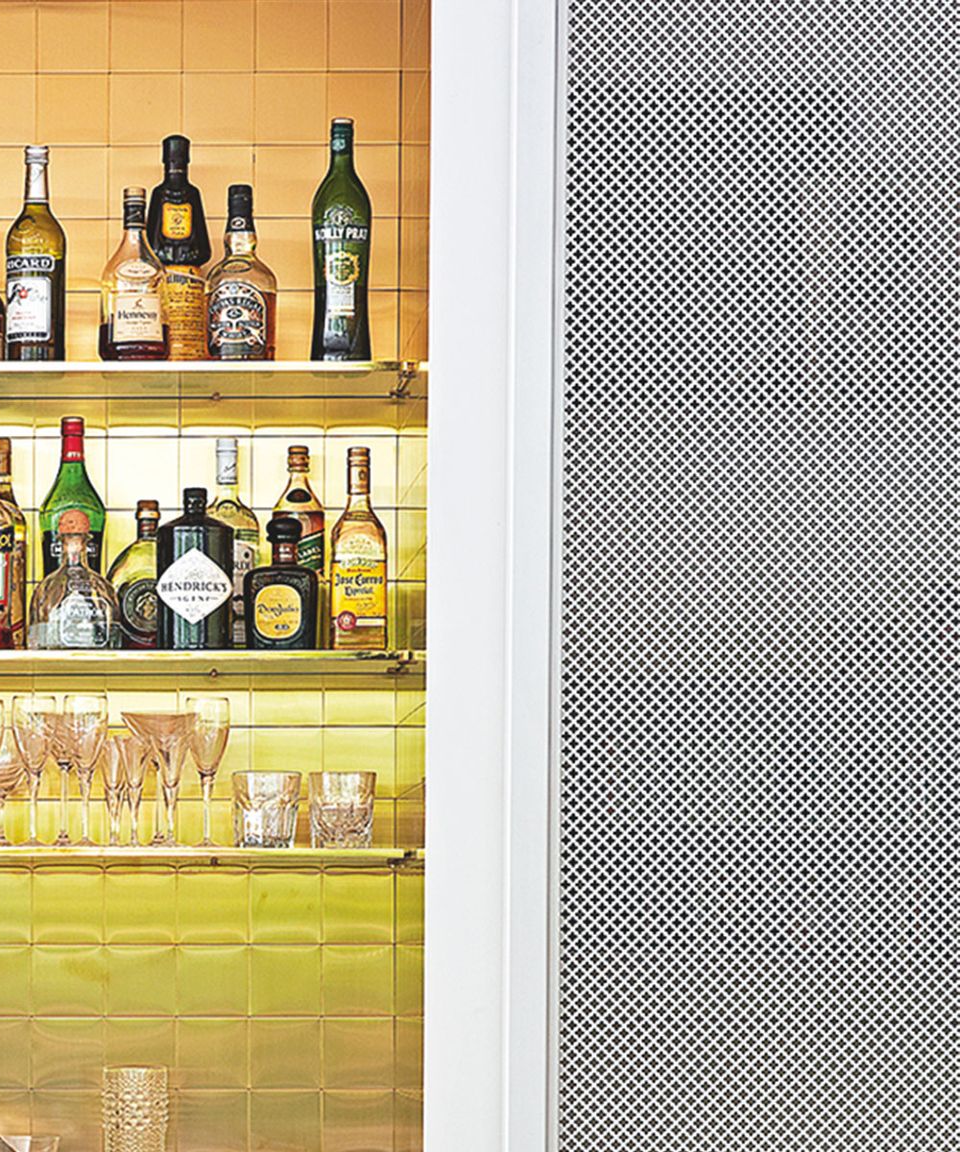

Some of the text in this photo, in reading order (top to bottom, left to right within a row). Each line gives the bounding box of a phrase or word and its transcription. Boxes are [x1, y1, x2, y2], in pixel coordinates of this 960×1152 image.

[345, 226, 368, 240] PRAT
[117, 311, 158, 321] Hennessy
[161, 580, 228, 594] HENDRICK'S
